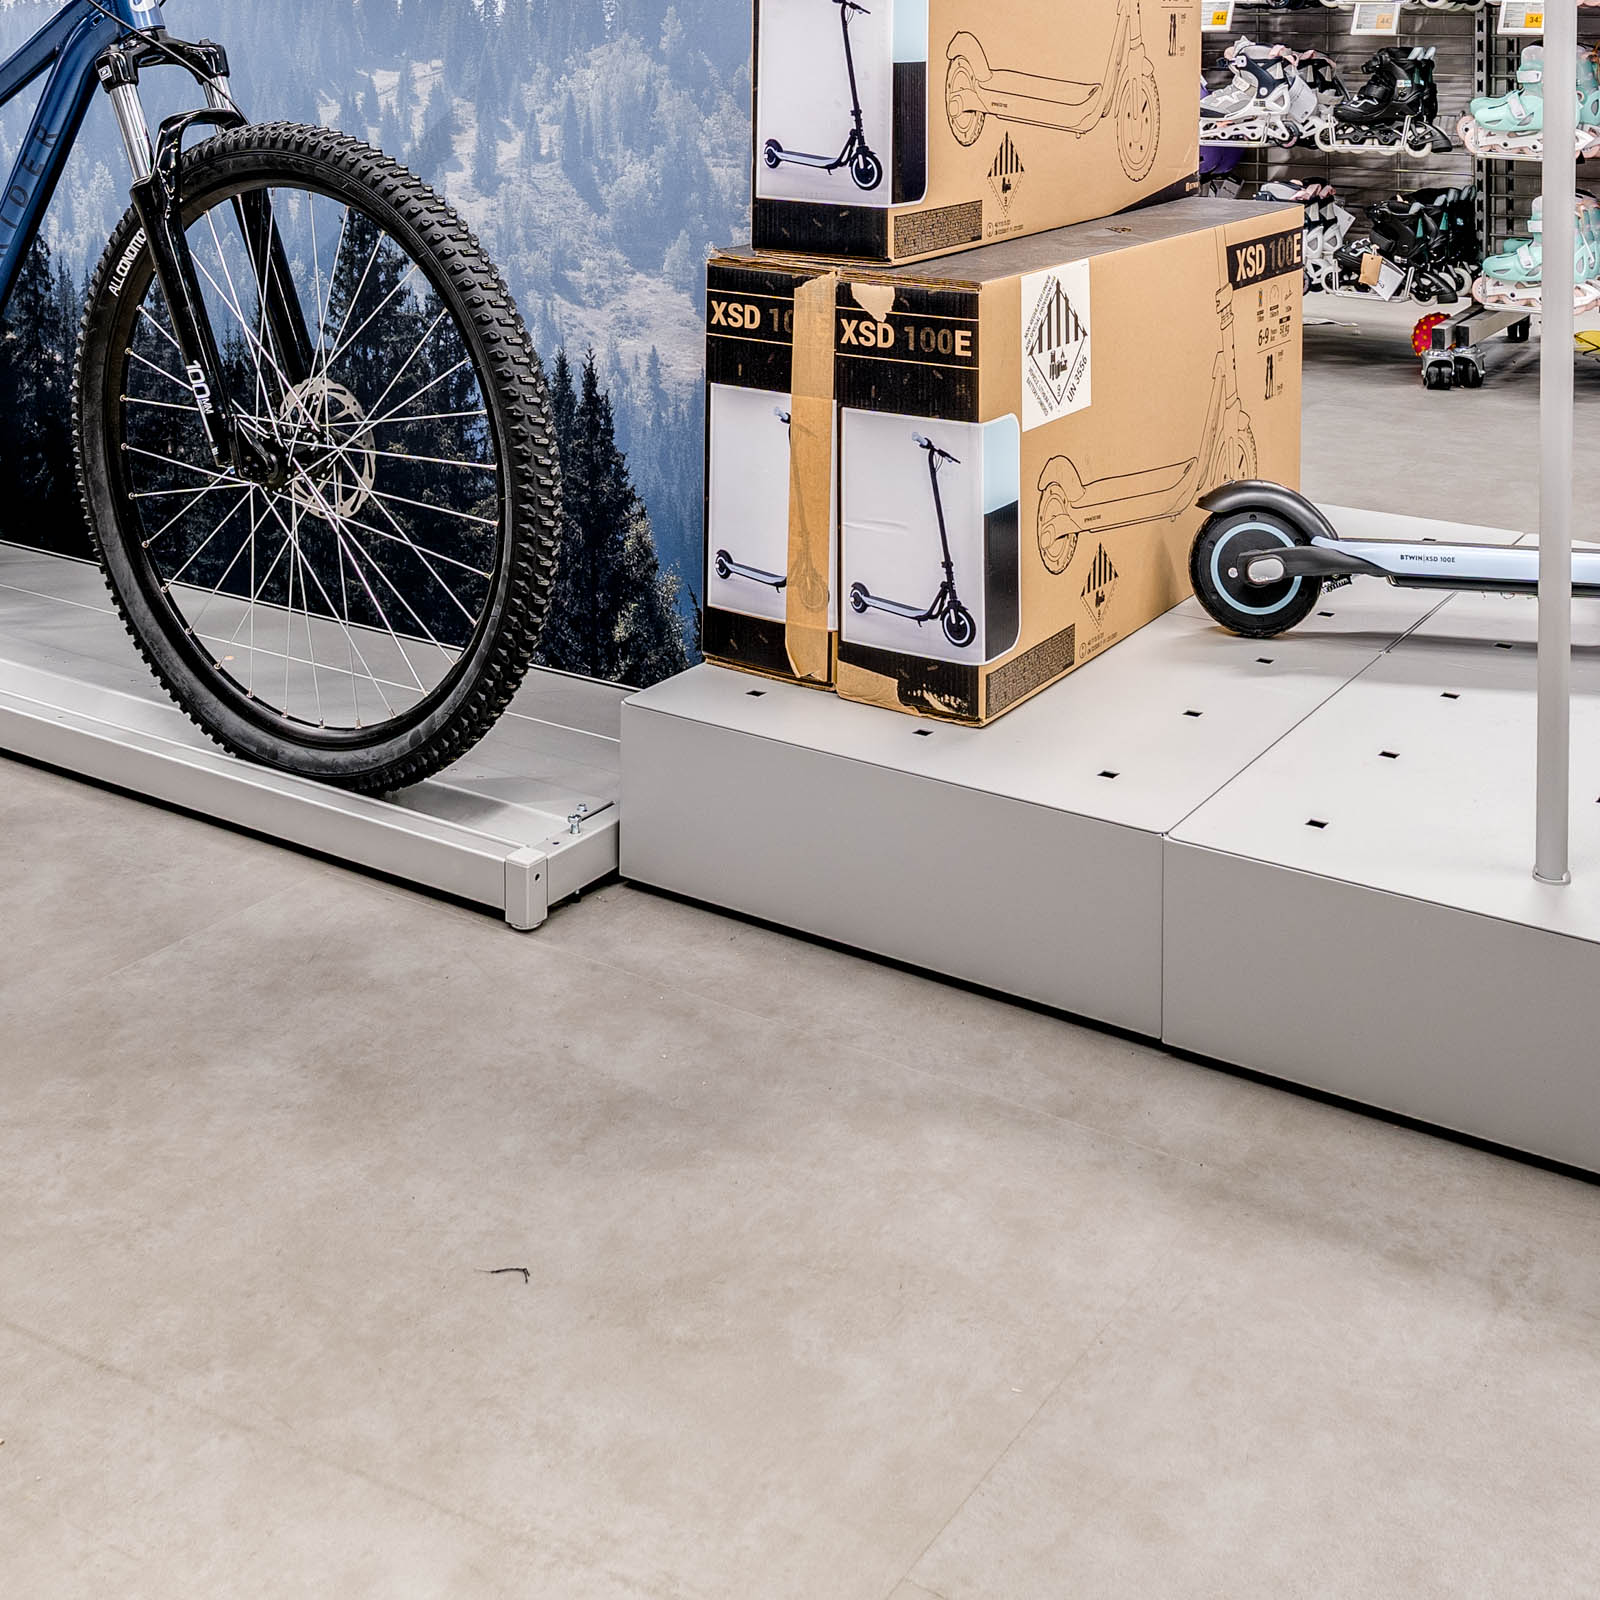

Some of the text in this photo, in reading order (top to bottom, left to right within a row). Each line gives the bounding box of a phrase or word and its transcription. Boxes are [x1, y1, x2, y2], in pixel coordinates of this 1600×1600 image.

[108, 227, 148, 296] ALL CONDITIO
[1236, 232, 1301, 282] XSD 100E
[710, 301, 794, 333] XSD 10
[840, 319, 972, 357] XSD 100E
[1258, 327, 1269, 346] 6-9
[1067, 355, 1088, 402] UN 3556
